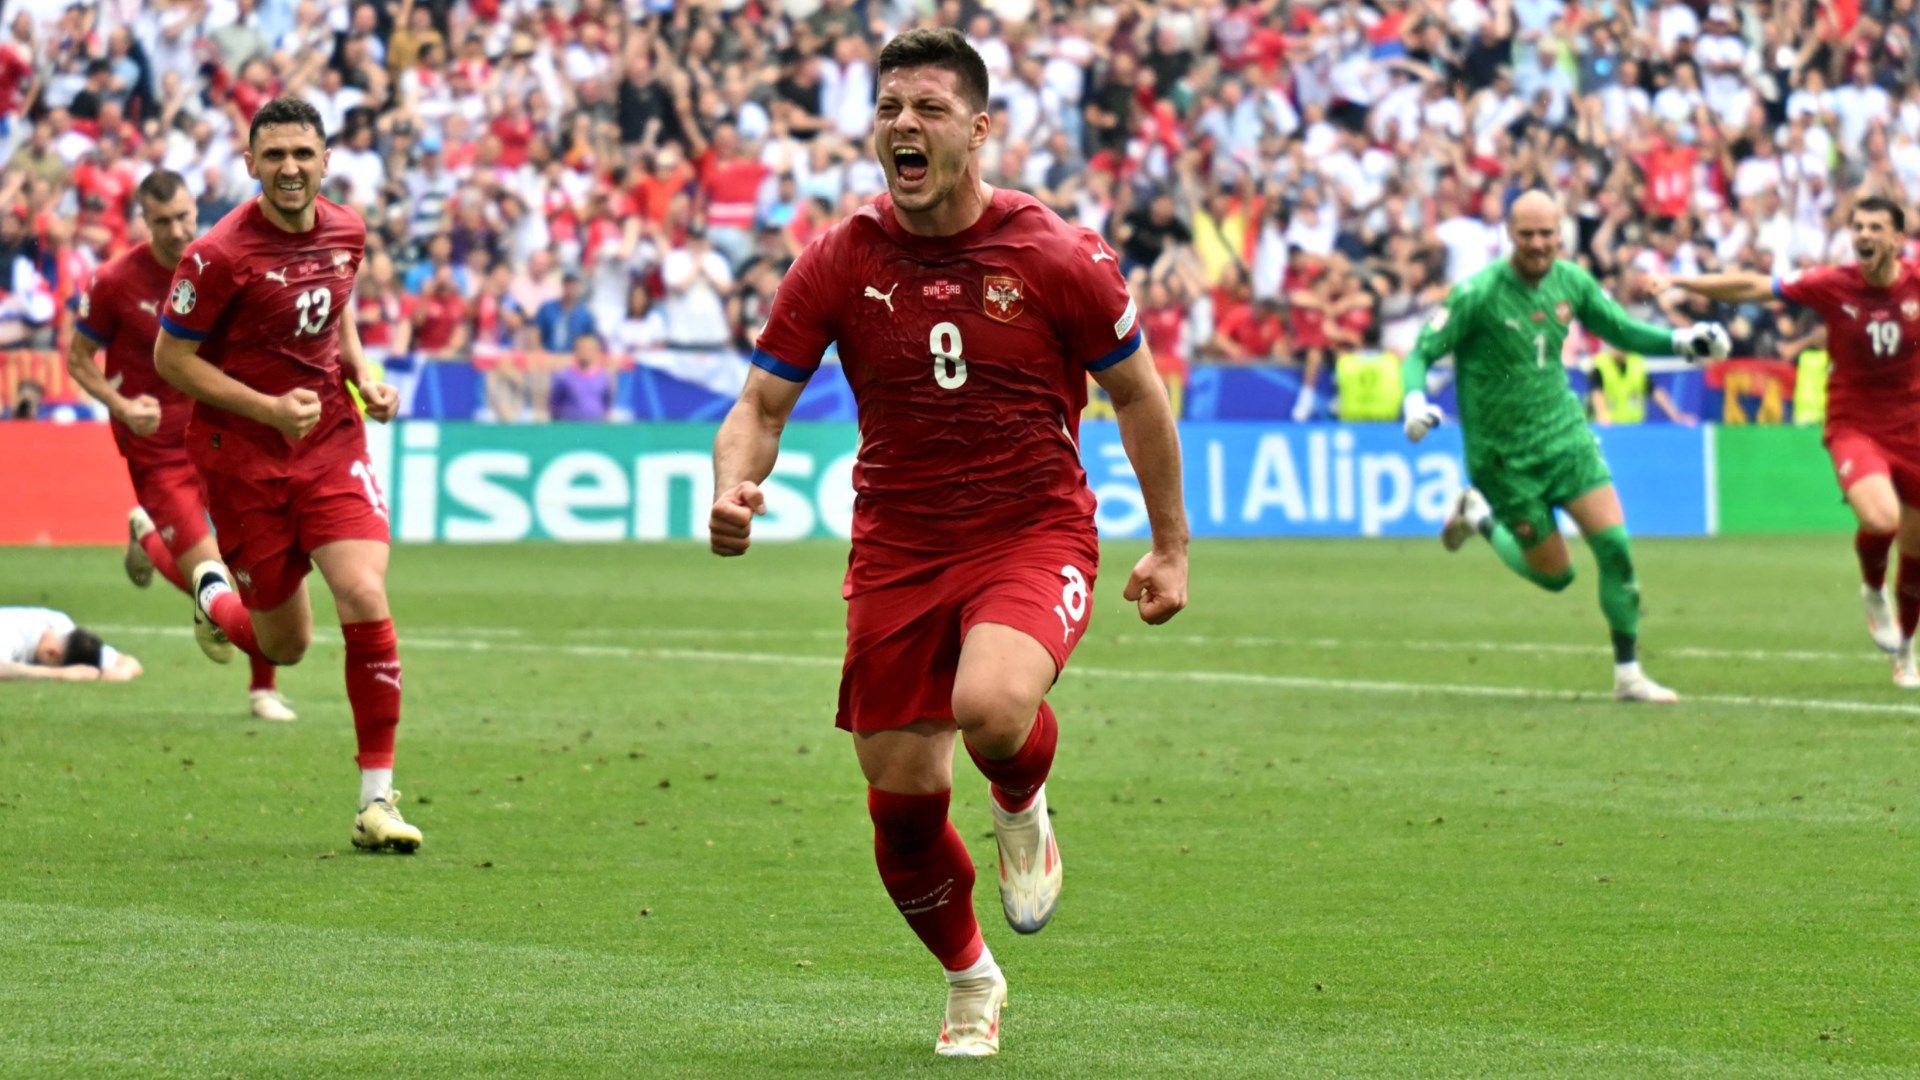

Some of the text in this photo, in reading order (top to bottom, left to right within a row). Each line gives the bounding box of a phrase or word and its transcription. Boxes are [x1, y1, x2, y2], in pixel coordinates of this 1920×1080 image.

[295, 287, 332, 336] 13
[1866, 321, 1901, 356] 19
[929, 321, 968, 390] 8
[1533, 334, 1545, 369] 1
[365, 421, 860, 540] isens
[1242, 430, 1461, 537] Alipa
[1061, 565, 1088, 621] 8
